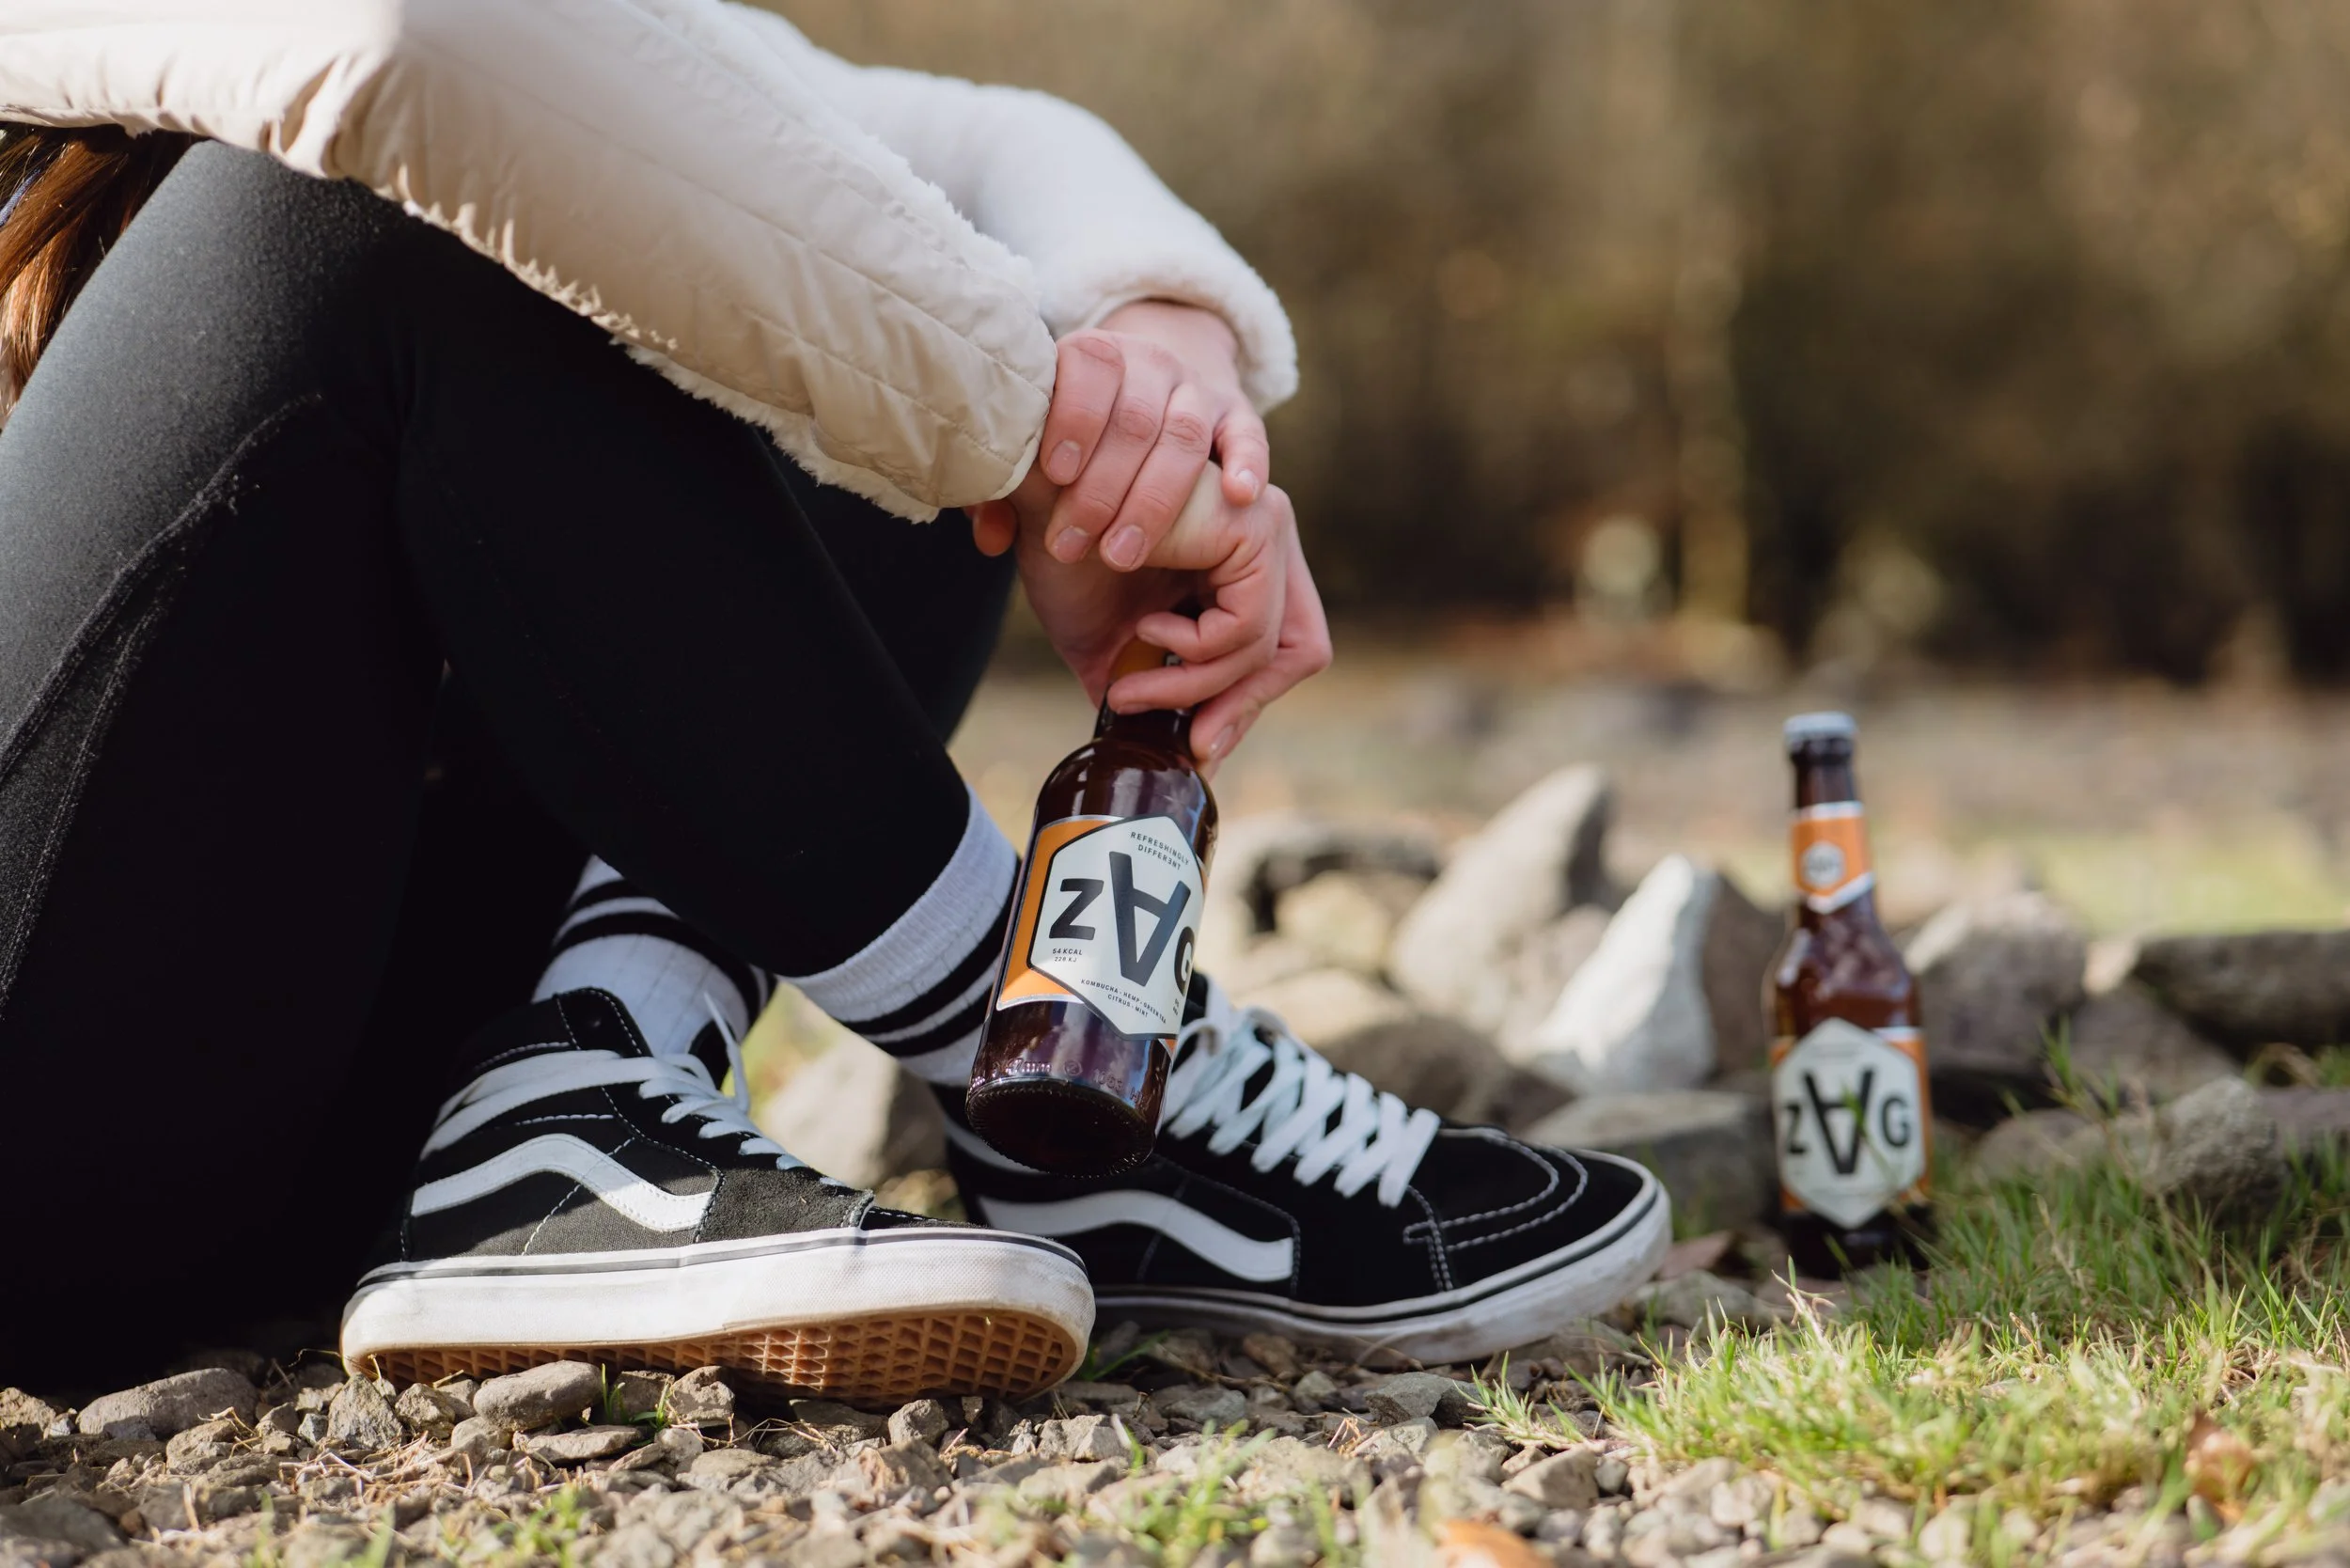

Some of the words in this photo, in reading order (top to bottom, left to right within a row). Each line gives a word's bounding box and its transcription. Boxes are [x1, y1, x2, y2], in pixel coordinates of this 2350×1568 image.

[1131, 831, 1189, 865] REFRESHINGLY
[1081, 979, 1119, 994] KOMBUCHA
[1123, 992, 1140, 1003] HEMP
[1107, 994, 1131, 1007] CITRUS
[1135, 1006, 1149, 1018] MINT
